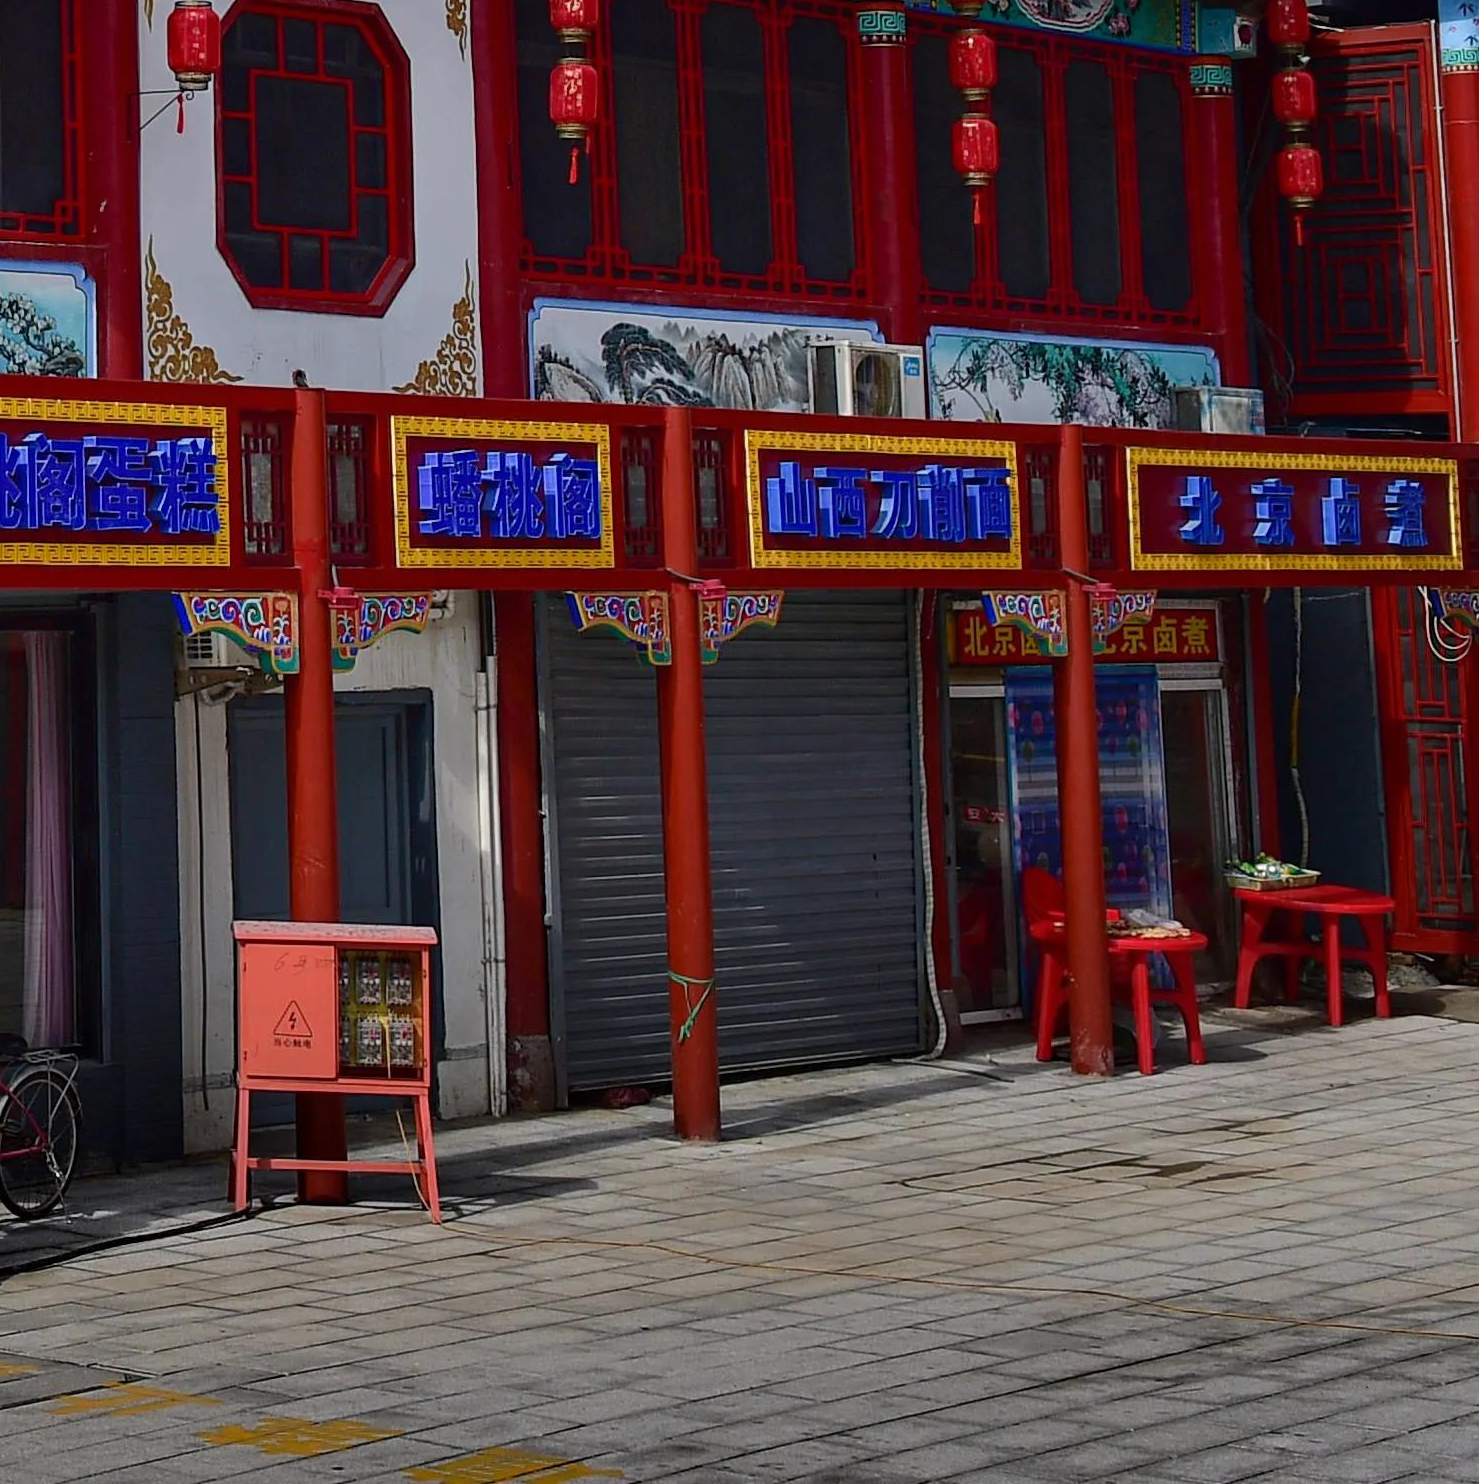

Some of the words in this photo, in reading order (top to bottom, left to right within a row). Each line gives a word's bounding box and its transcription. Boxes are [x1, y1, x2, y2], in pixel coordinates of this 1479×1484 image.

[417, 450, 603, 540] 蟠桃阁
[766, 460, 1013, 543] 山西刀削面
[1179, 474, 1429, 547] 北京卤煮
